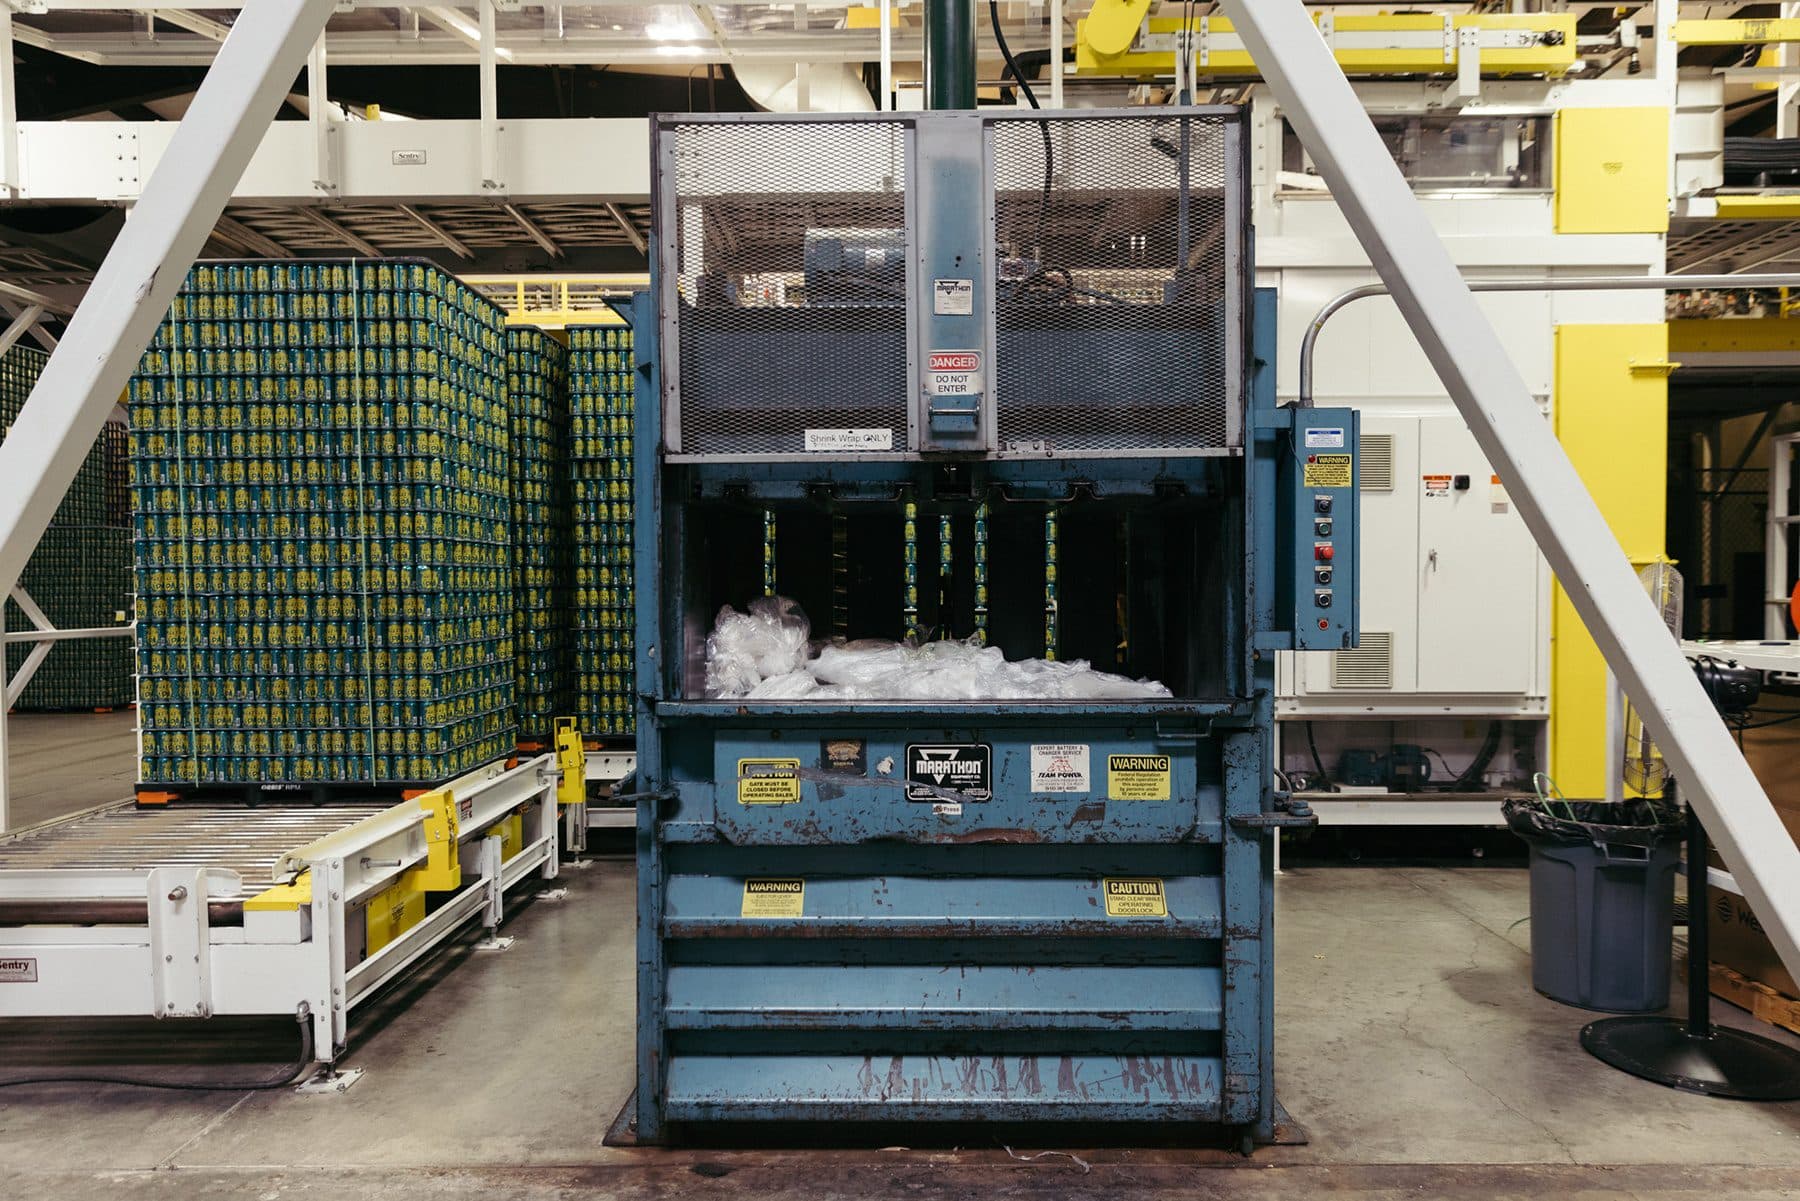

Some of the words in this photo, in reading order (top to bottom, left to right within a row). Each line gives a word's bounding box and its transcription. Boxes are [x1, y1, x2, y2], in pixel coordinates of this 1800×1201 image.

[929, 357, 976, 367] DANGER
[936, 375, 949, 383] DO
[951, 375, 968, 383] NOT
[938, 384, 967, 393] ENTER
[810, 434, 836, 442] Shrink
[839, 434, 861, 443] Wrap
[863, 434, 888, 442] ONLY
[1318, 456, 1349, 464] WARNING
[916, 760, 981, 774] MARATHON
[1112, 758, 1167, 770] WARNING
[750, 882, 801, 892] WARNING
[1110, 882, 1158, 894] CAUTION
